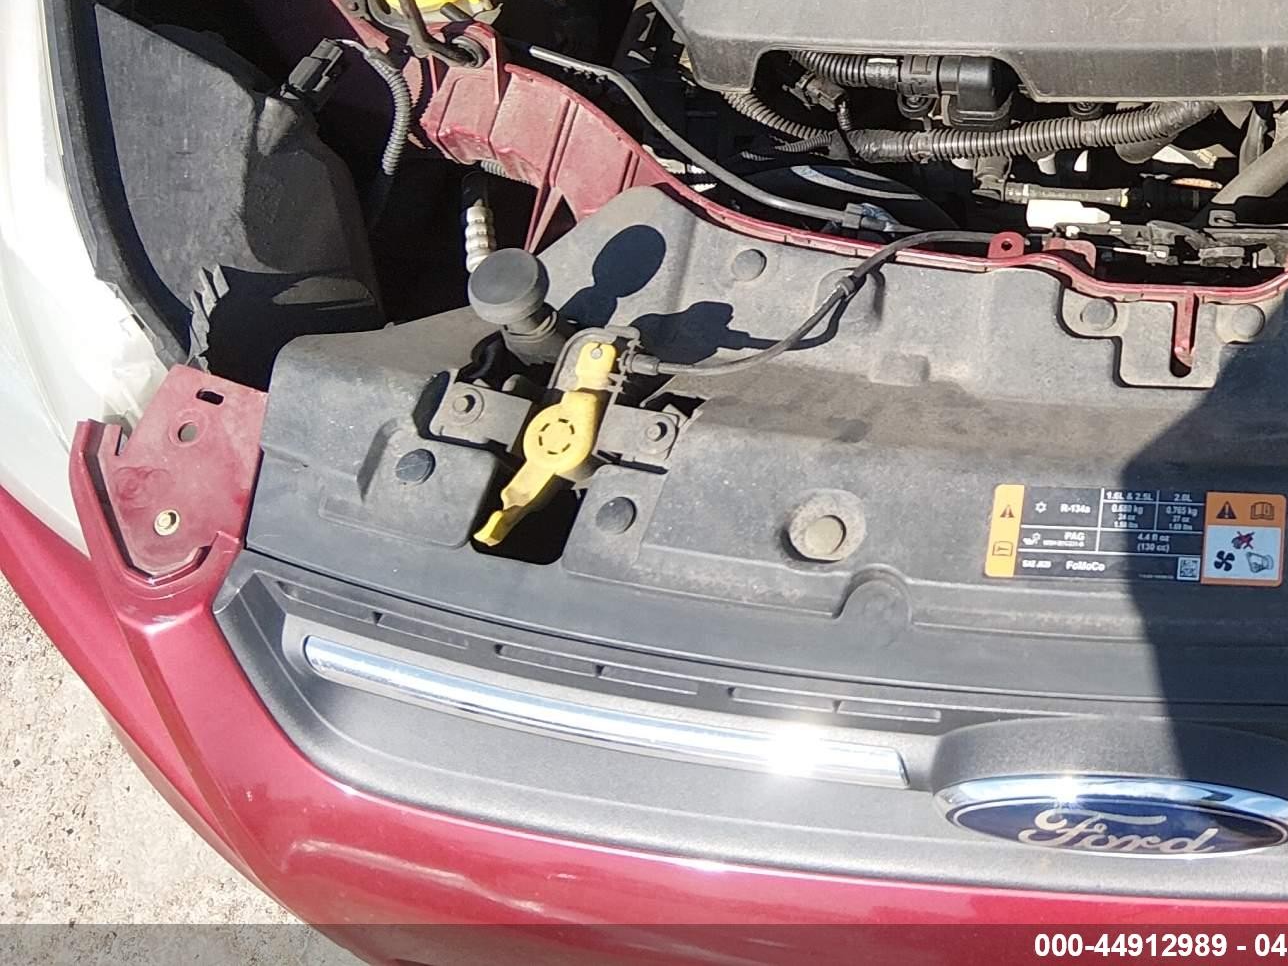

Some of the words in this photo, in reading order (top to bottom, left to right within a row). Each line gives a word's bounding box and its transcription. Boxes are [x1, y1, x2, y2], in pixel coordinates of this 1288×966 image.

[1060, 503, 1091, 514] R-134a
[1133, 505, 1143, 515] kg
[1187, 507, 1198, 517] kg
[1064, 531, 1085, 541] PAG
[1065, 560, 1105, 572] FoMoCo
[1018, 808, 1219, 853] Ford
